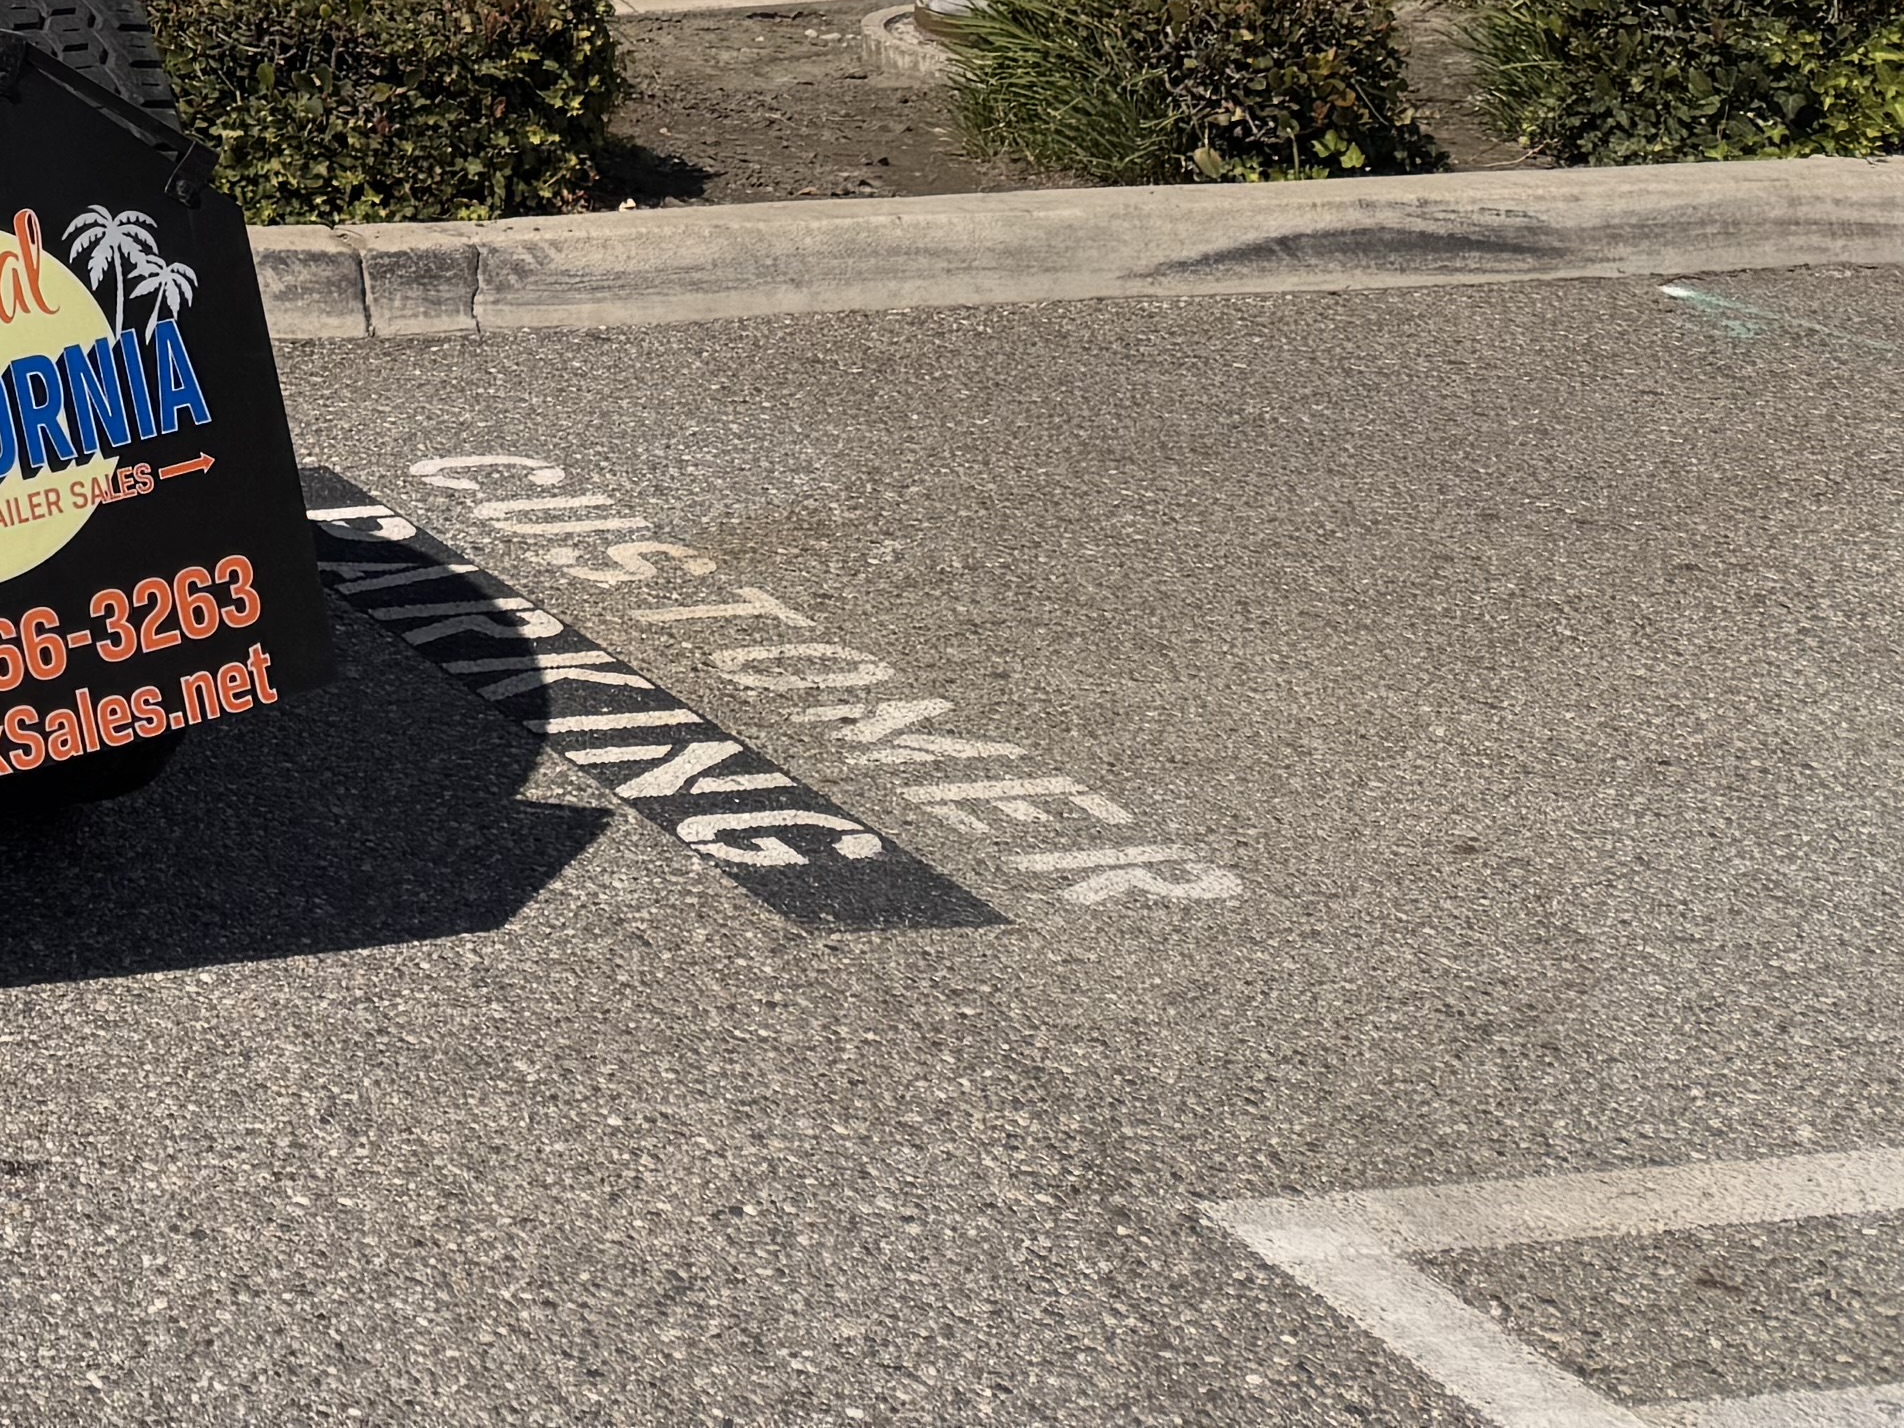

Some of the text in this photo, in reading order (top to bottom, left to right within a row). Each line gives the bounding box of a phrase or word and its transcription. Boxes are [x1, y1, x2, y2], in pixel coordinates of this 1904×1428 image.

[70, 463, 155, 512] SALES
[306, 503, 883, 867] PARKING
[409, 455, 1244, 905] CUSTOMER
